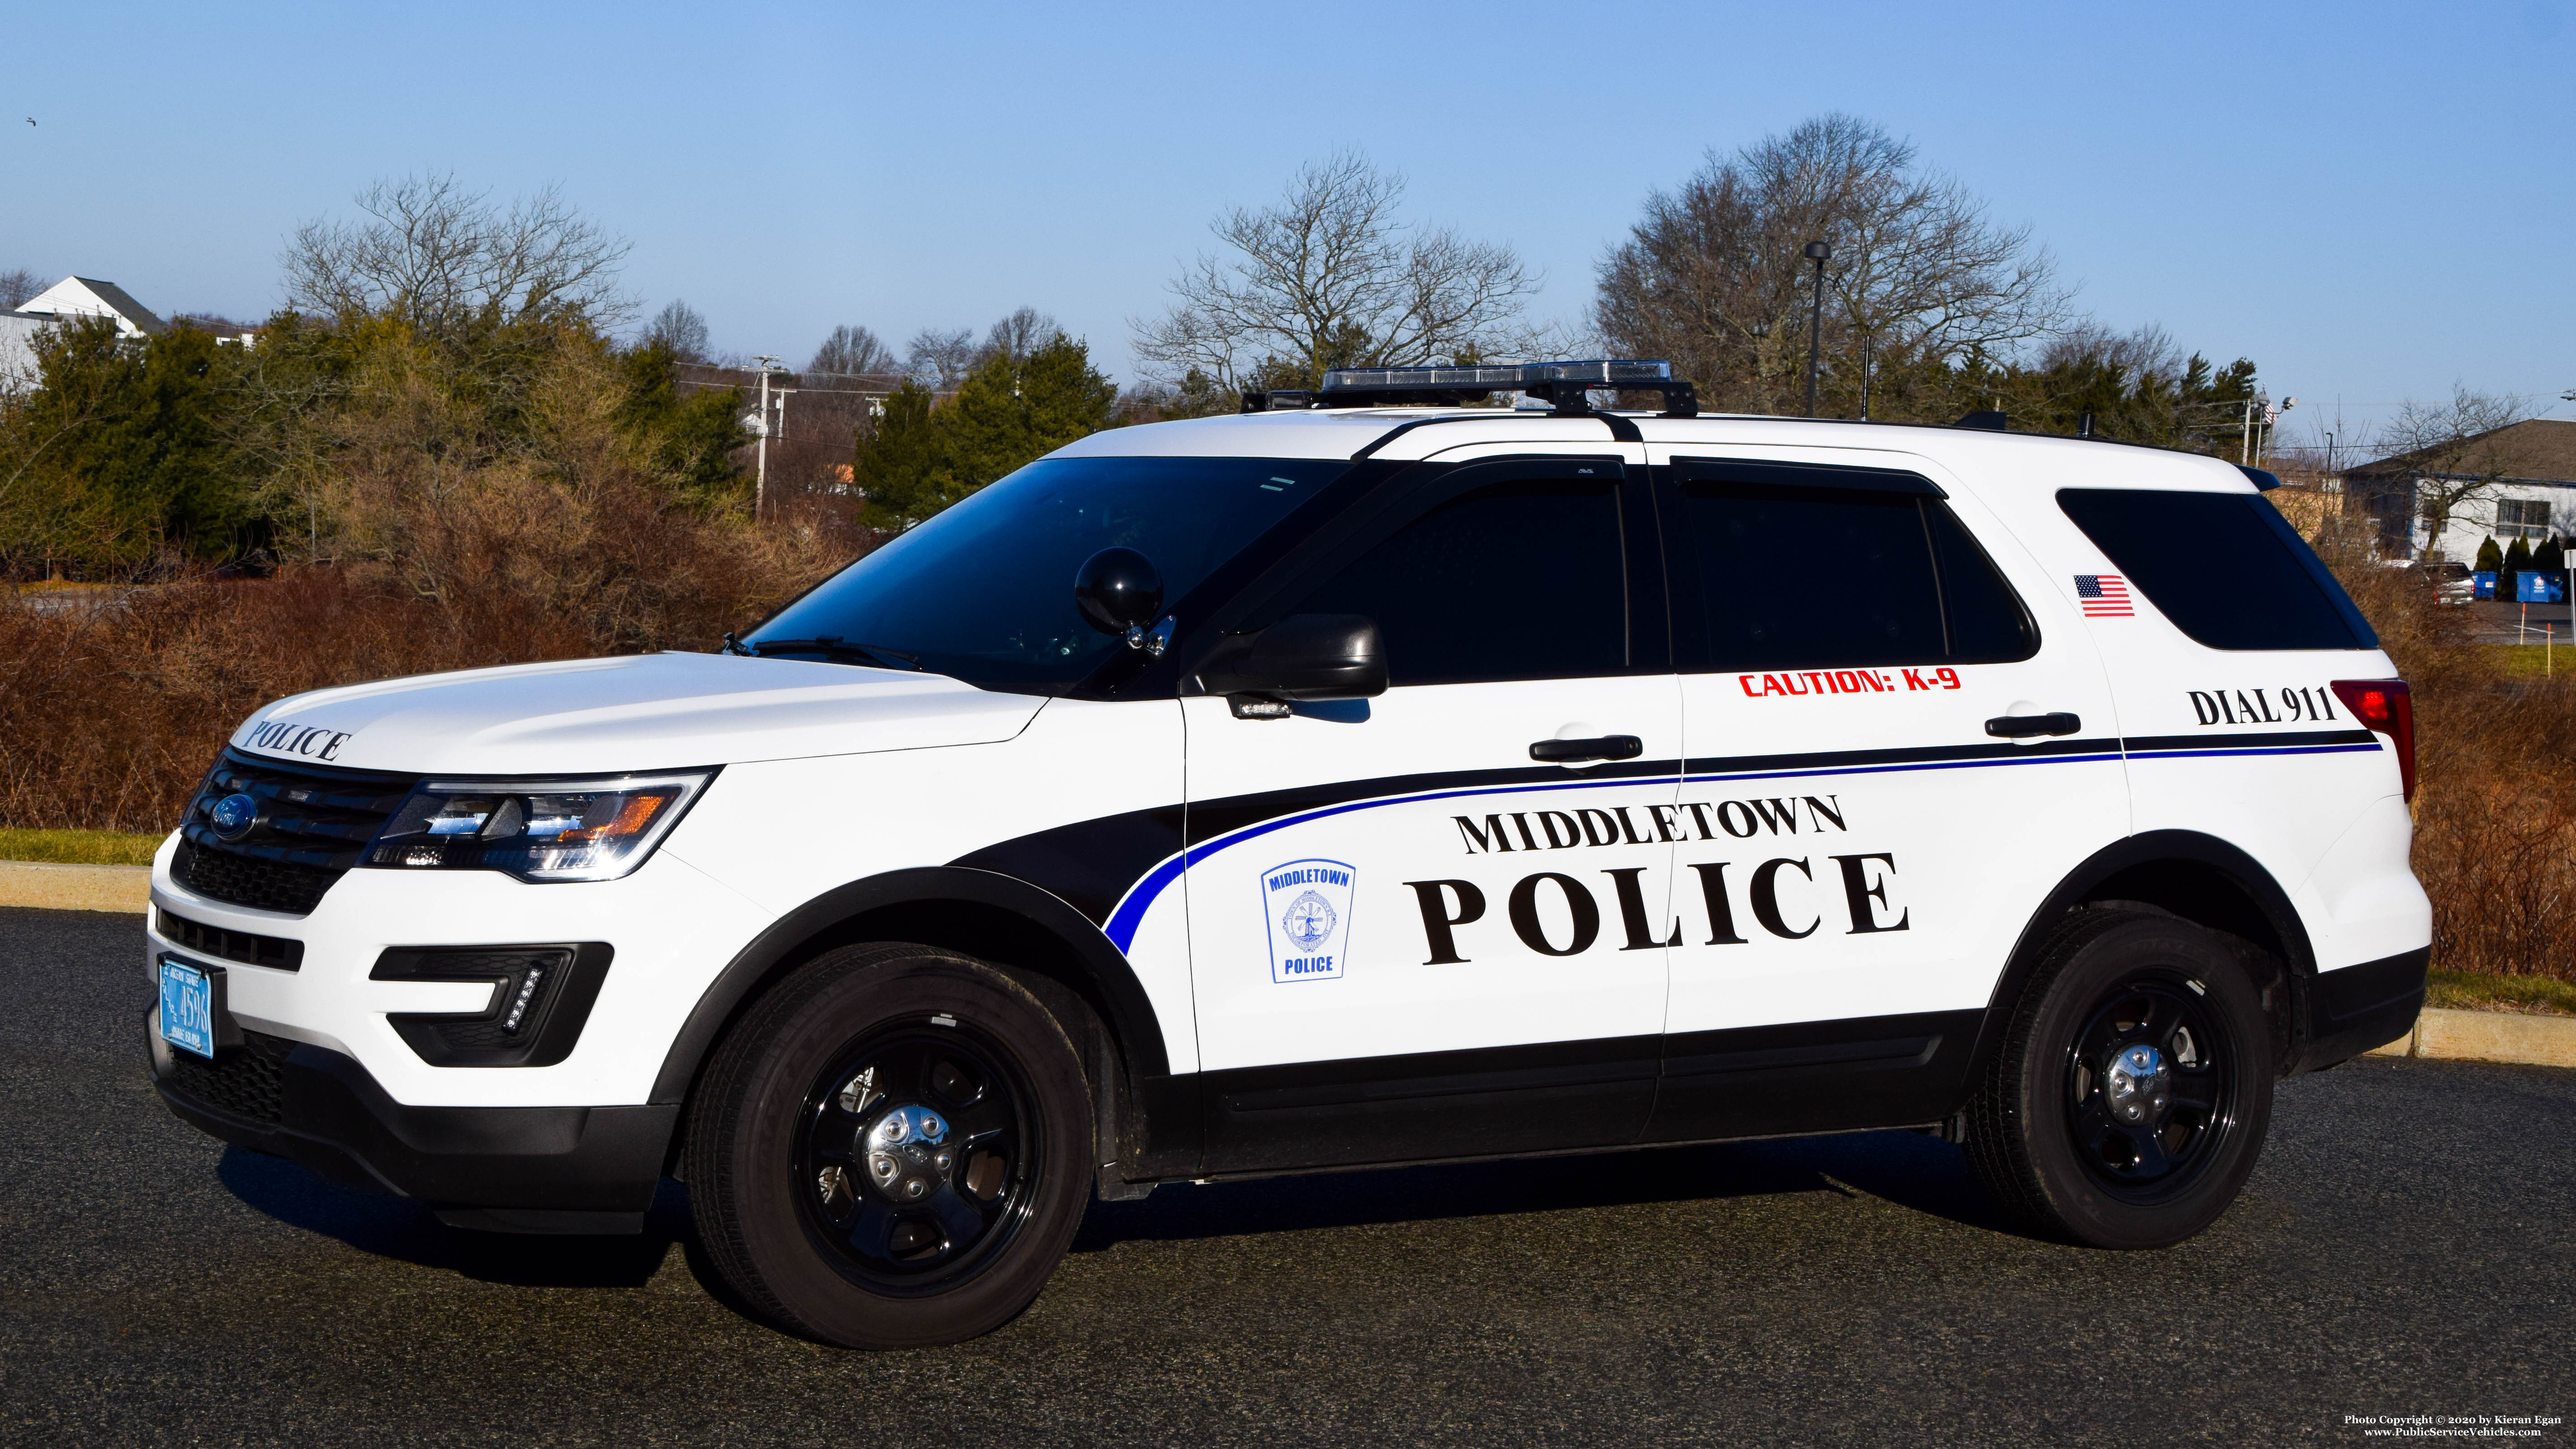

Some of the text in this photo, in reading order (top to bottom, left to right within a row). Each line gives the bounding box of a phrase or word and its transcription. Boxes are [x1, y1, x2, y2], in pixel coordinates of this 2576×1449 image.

[1739, 668, 1960, 696] CAUTION: K-9
[2186, 687, 2337, 725] DIAL 911
[242, 721, 352, 761] POLICE
[214, 800, 241, 826] Ford
[1450, 795, 1847, 854] MIDDLETOWN
[1269, 869, 1350, 891] MIDDLETOWN
[1402, 853, 1909, 965] POLICE
[1285, 956, 1332, 974] POLICE
[180, 985, 208, 1033] 4596
